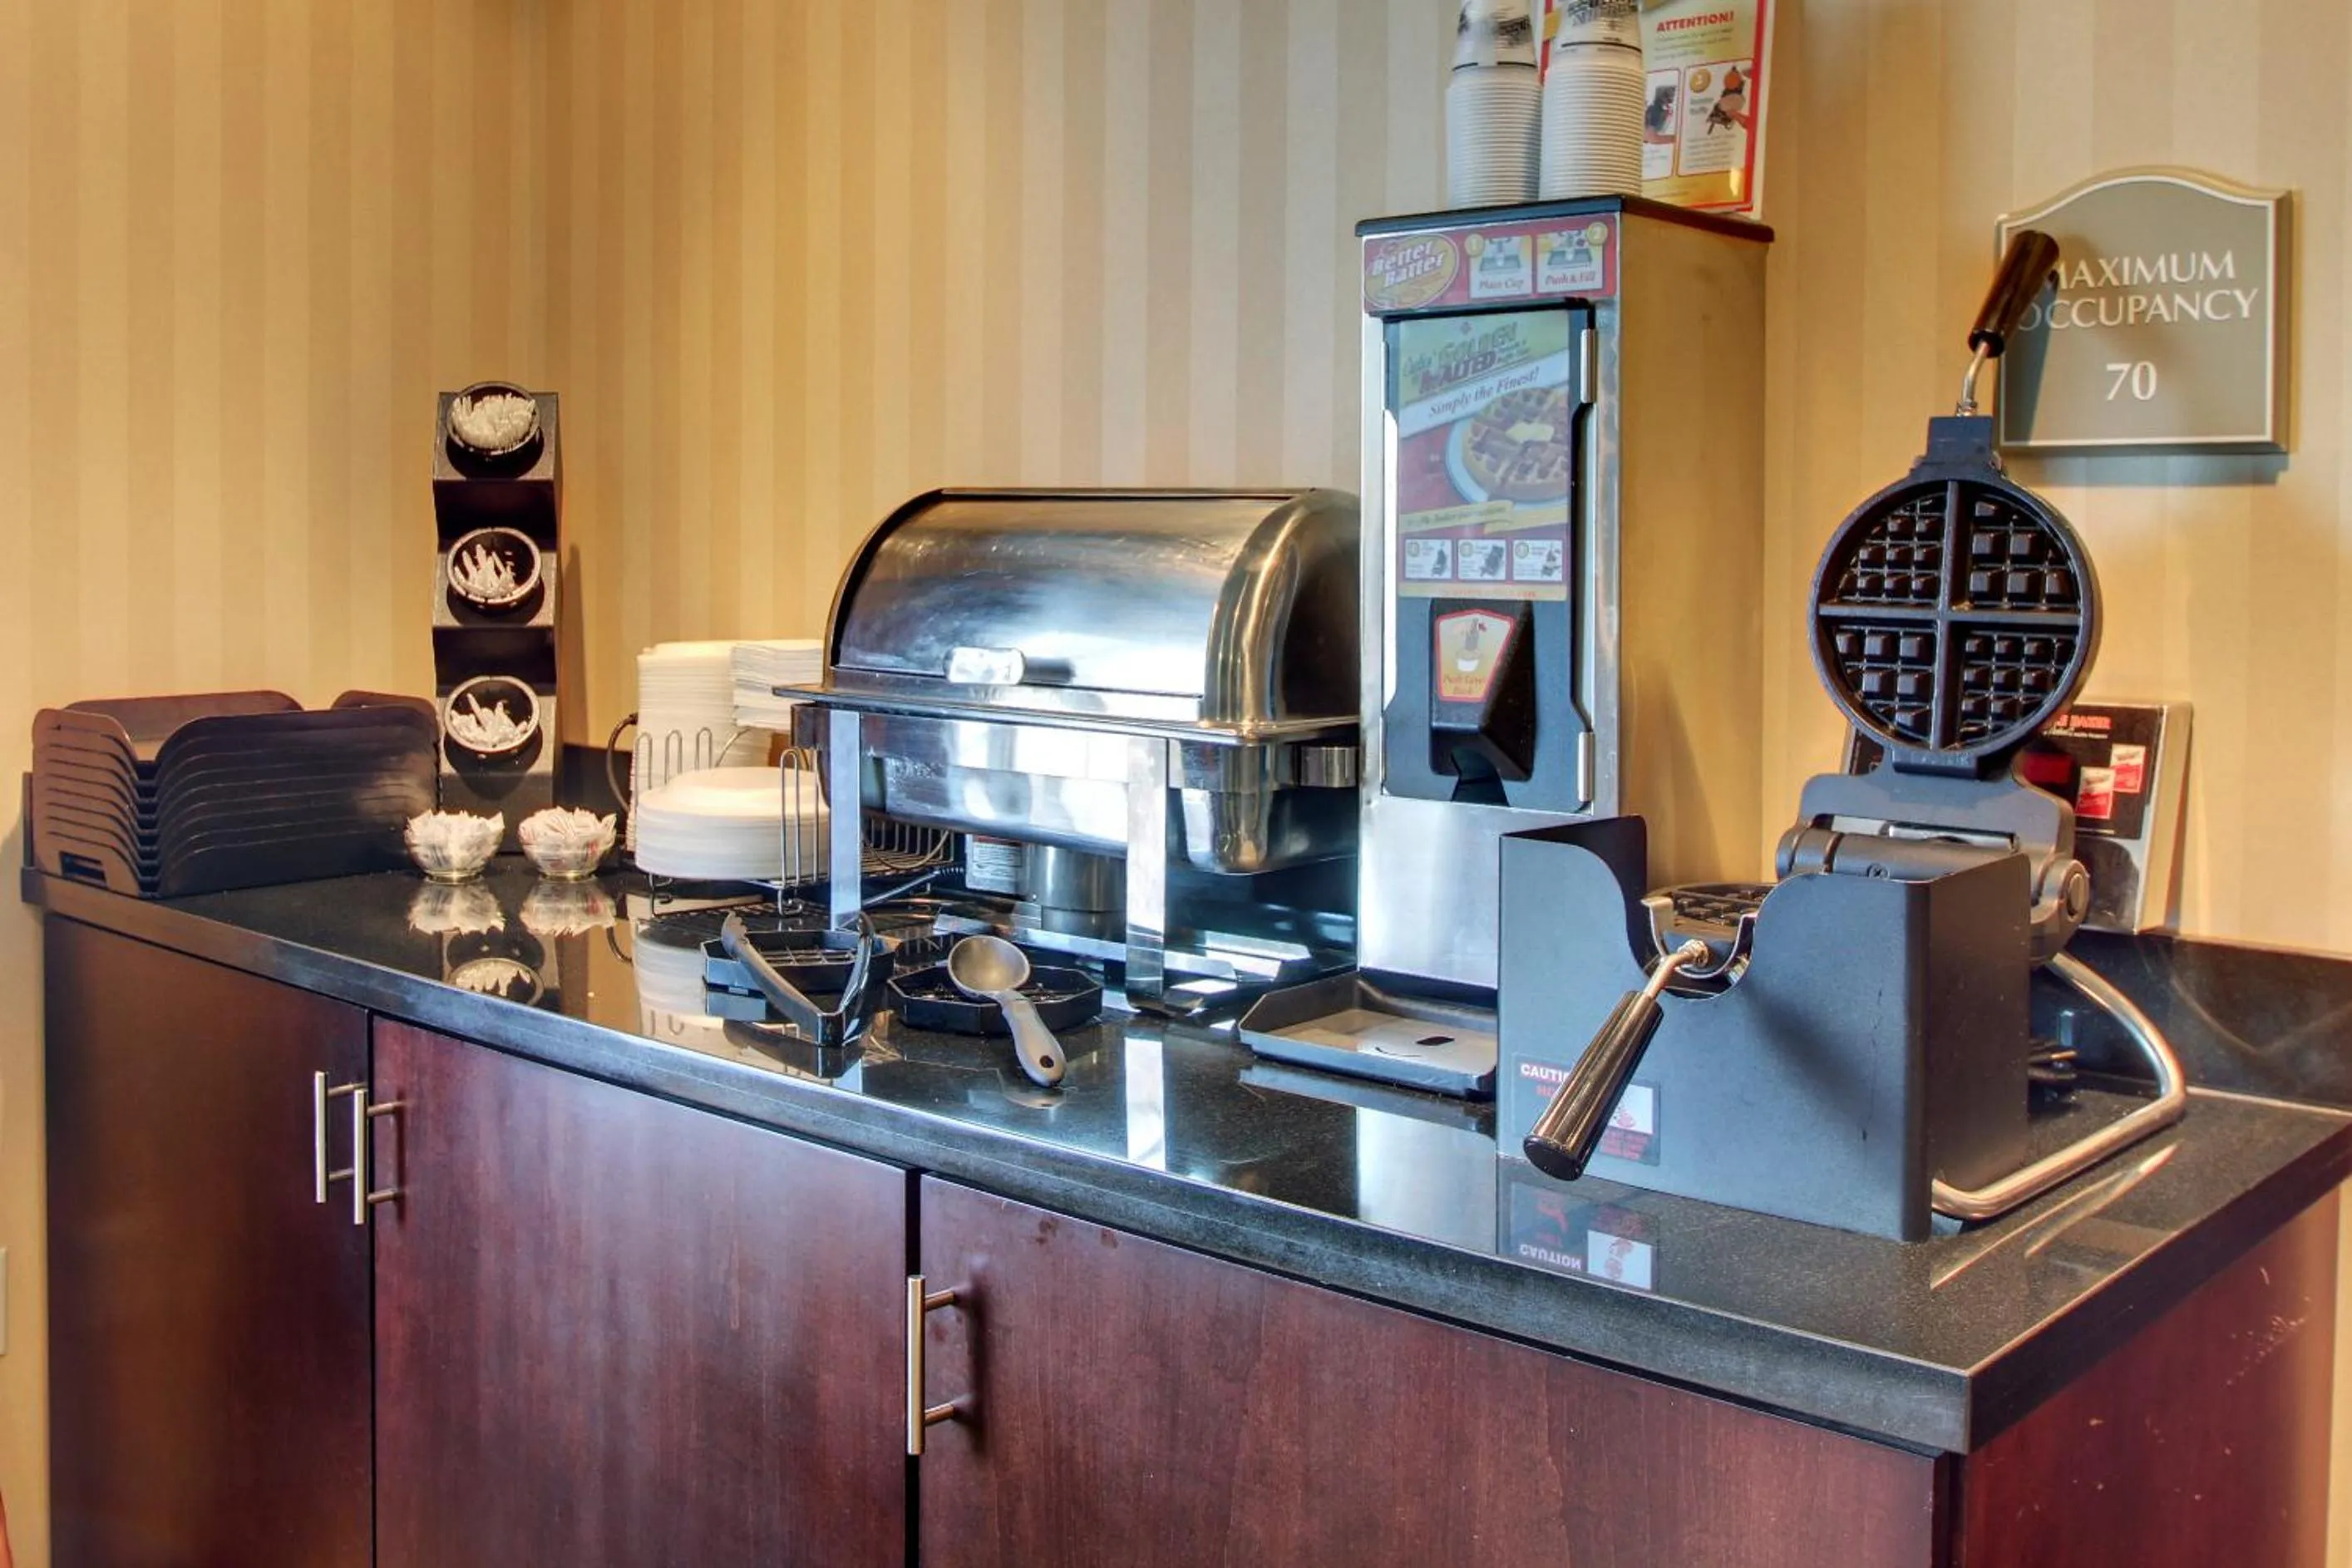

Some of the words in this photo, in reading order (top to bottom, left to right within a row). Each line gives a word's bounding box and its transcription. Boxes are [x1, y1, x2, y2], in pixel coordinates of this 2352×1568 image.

[1656, 10, 1734, 32] ATTENTION!
[1372, 240, 1433, 276] Better
[1383, 250, 1447, 288] Batter
[1429, 391, 1472, 417] Simply
[1474, 385, 1494, 401] the
[1497, 366, 1540, 393] Finest!
[2105, 360, 2158, 402] 70
[1521, 1063, 1573, 1082] CAUTI
